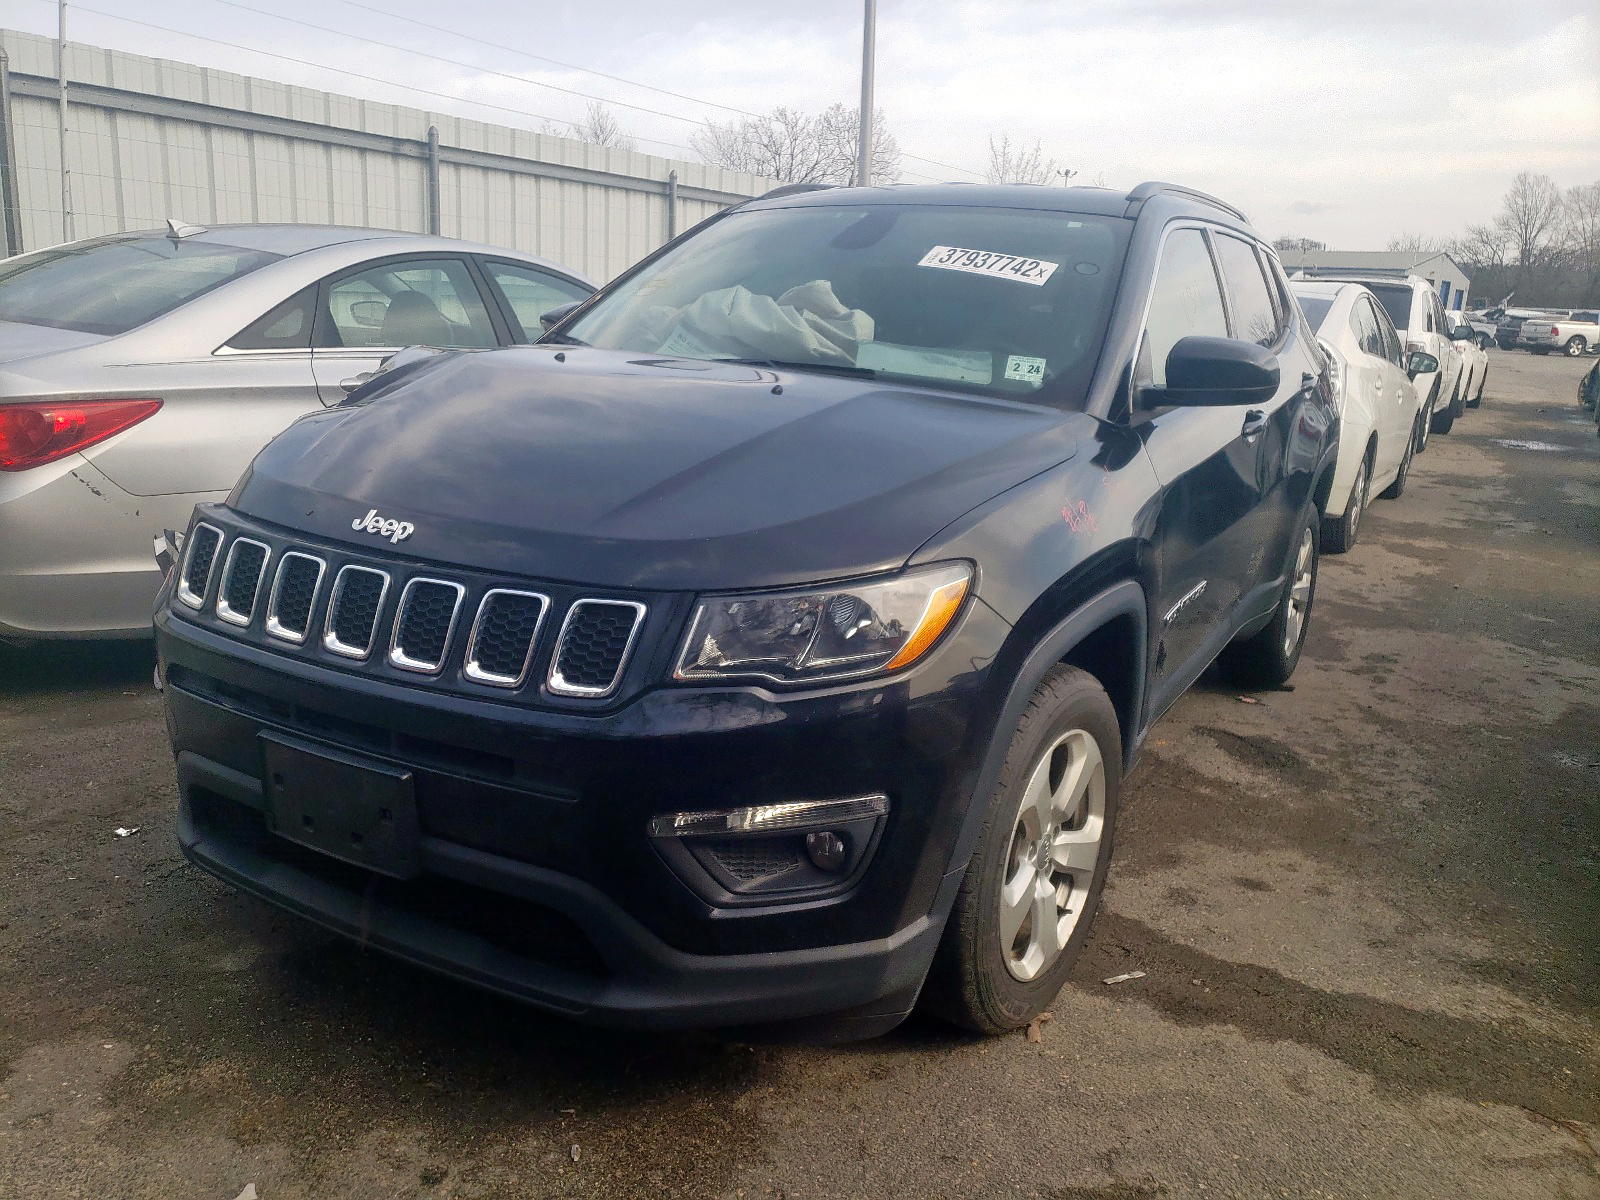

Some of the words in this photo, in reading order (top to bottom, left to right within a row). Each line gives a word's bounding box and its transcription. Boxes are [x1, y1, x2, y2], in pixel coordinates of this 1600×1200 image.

[1013, 362, 1020, 372] 2
[1027, 364, 1040, 375] 24
[352, 509, 414, 544] Jeep
